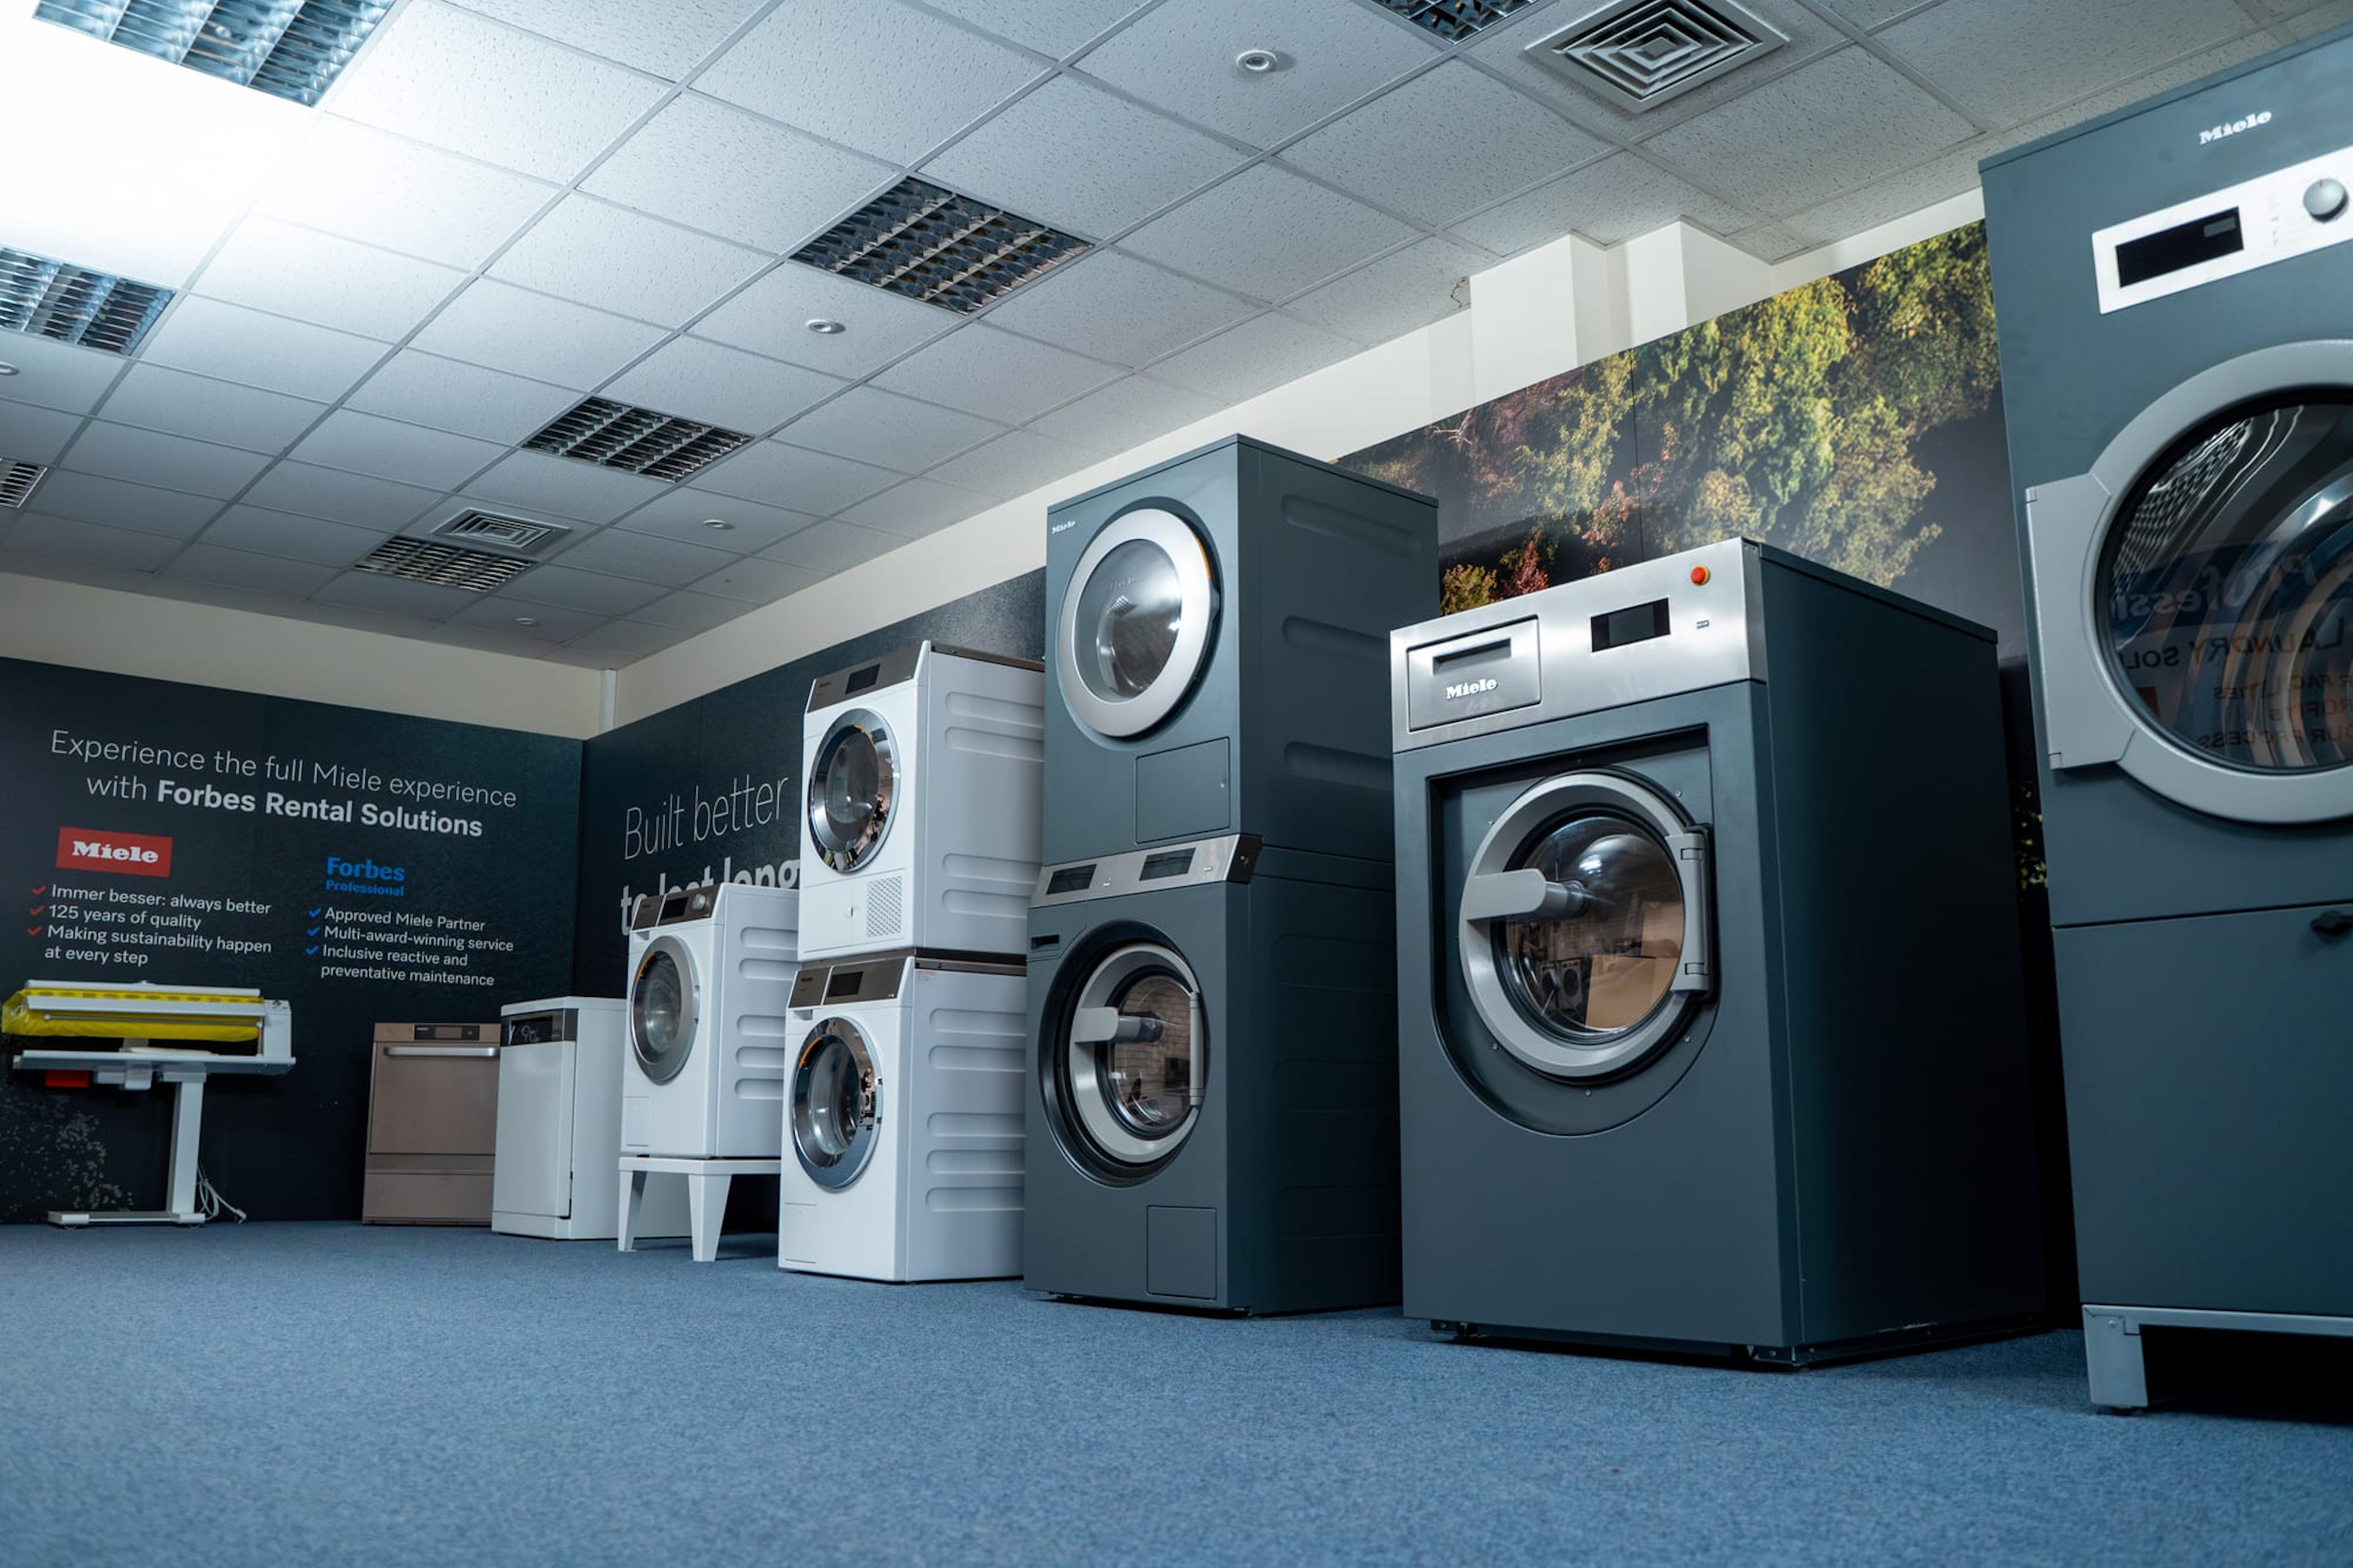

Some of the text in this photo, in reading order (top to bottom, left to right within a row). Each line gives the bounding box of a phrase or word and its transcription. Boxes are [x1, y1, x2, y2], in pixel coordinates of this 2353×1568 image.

[2199, 111, 2272, 145] Miele
[1051, 520, 1077, 535] Miele
[1446, 678, 1498, 700] Miele
[51, 729, 517, 808] Experience the full Miele experience
[86, 775, 483, 837] with Forbes Rental Solutions
[624, 774, 789, 859] Built better
[72, 841, 158, 863] Miele
[326, 857, 405, 882] Forbes
[51, 884, 271, 914] Immer besser: always better
[325, 880, 404, 896] Professional
[48, 904, 202, 931] 125 years of quality
[325, 907, 485, 931] Approved Miele Partner
[47, 925, 271, 954] Making sustainability happen
[324, 925, 513, 951] Multi-award-winning service
[45, 946, 148, 966] at every step
[322, 944, 468, 966] Inclusive reactive and
[320, 965, 494, 986] preventative maintenance
